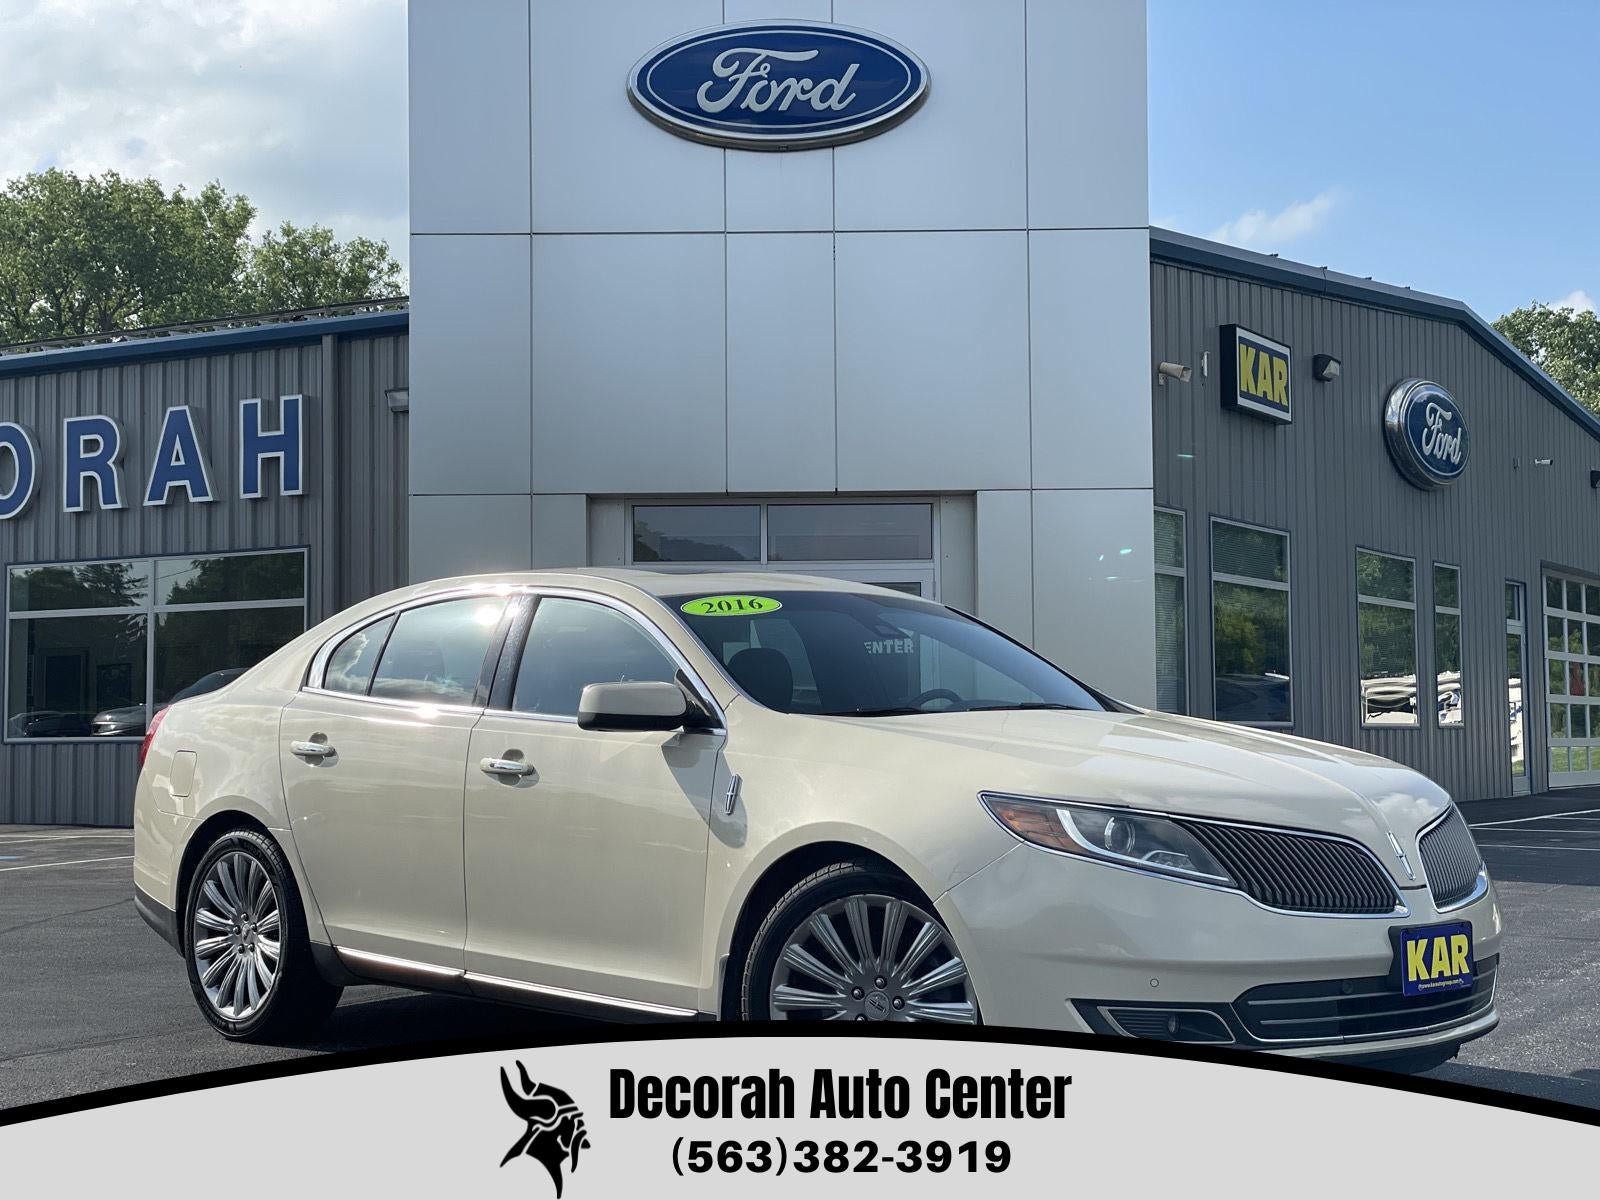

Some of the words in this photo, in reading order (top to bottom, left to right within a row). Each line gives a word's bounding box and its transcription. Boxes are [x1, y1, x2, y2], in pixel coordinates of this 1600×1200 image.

[696, 47, 860, 113] Ford
[1239, 343, 1289, 406] KAR
[1422, 402, 1463, 464] Ford
[701, 598, 763, 614] 2016
[1406, 934, 1470, 982] KAR
